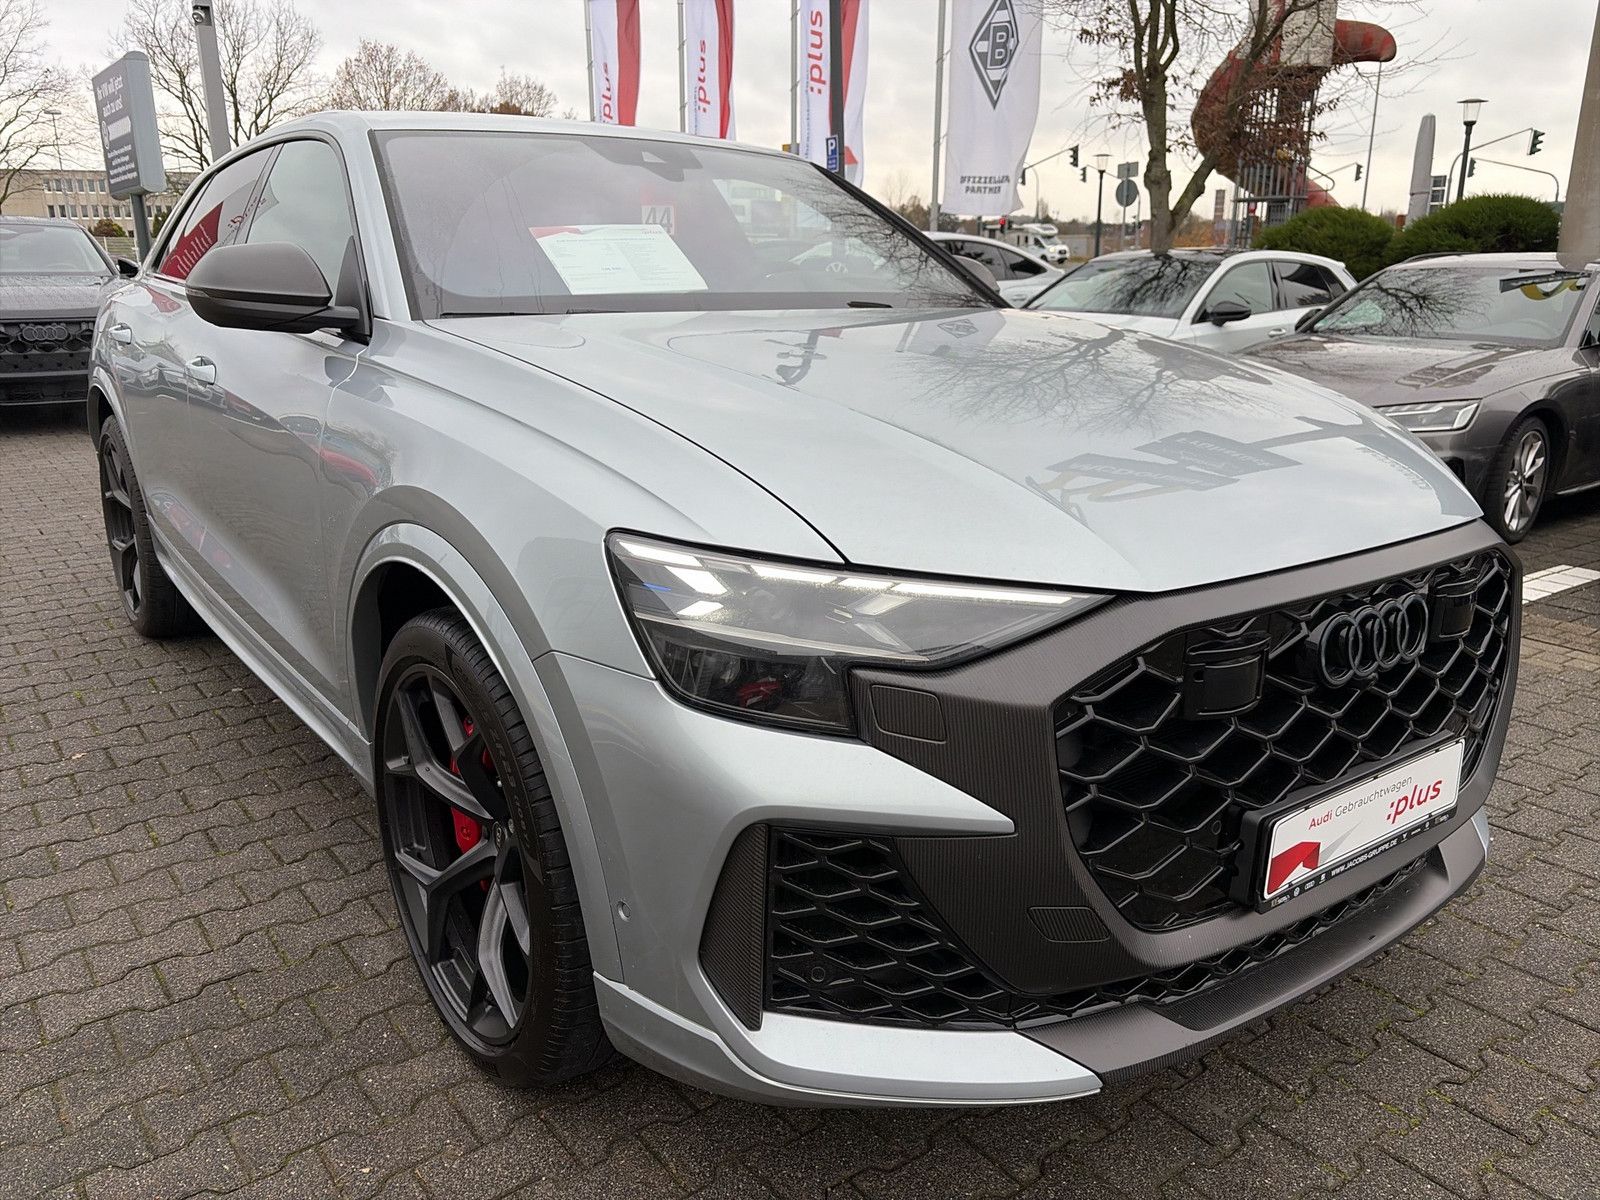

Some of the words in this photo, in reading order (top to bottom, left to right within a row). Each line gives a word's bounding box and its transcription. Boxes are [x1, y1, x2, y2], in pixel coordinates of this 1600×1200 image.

[807, 10, 827, 95] :plus
[827, 139, 836, 156] P
[1308, 810, 1333, 830] Audi
[1334, 776, 1413, 818] Gebrauchtwagen
[1386, 780, 1443, 825] :plus
